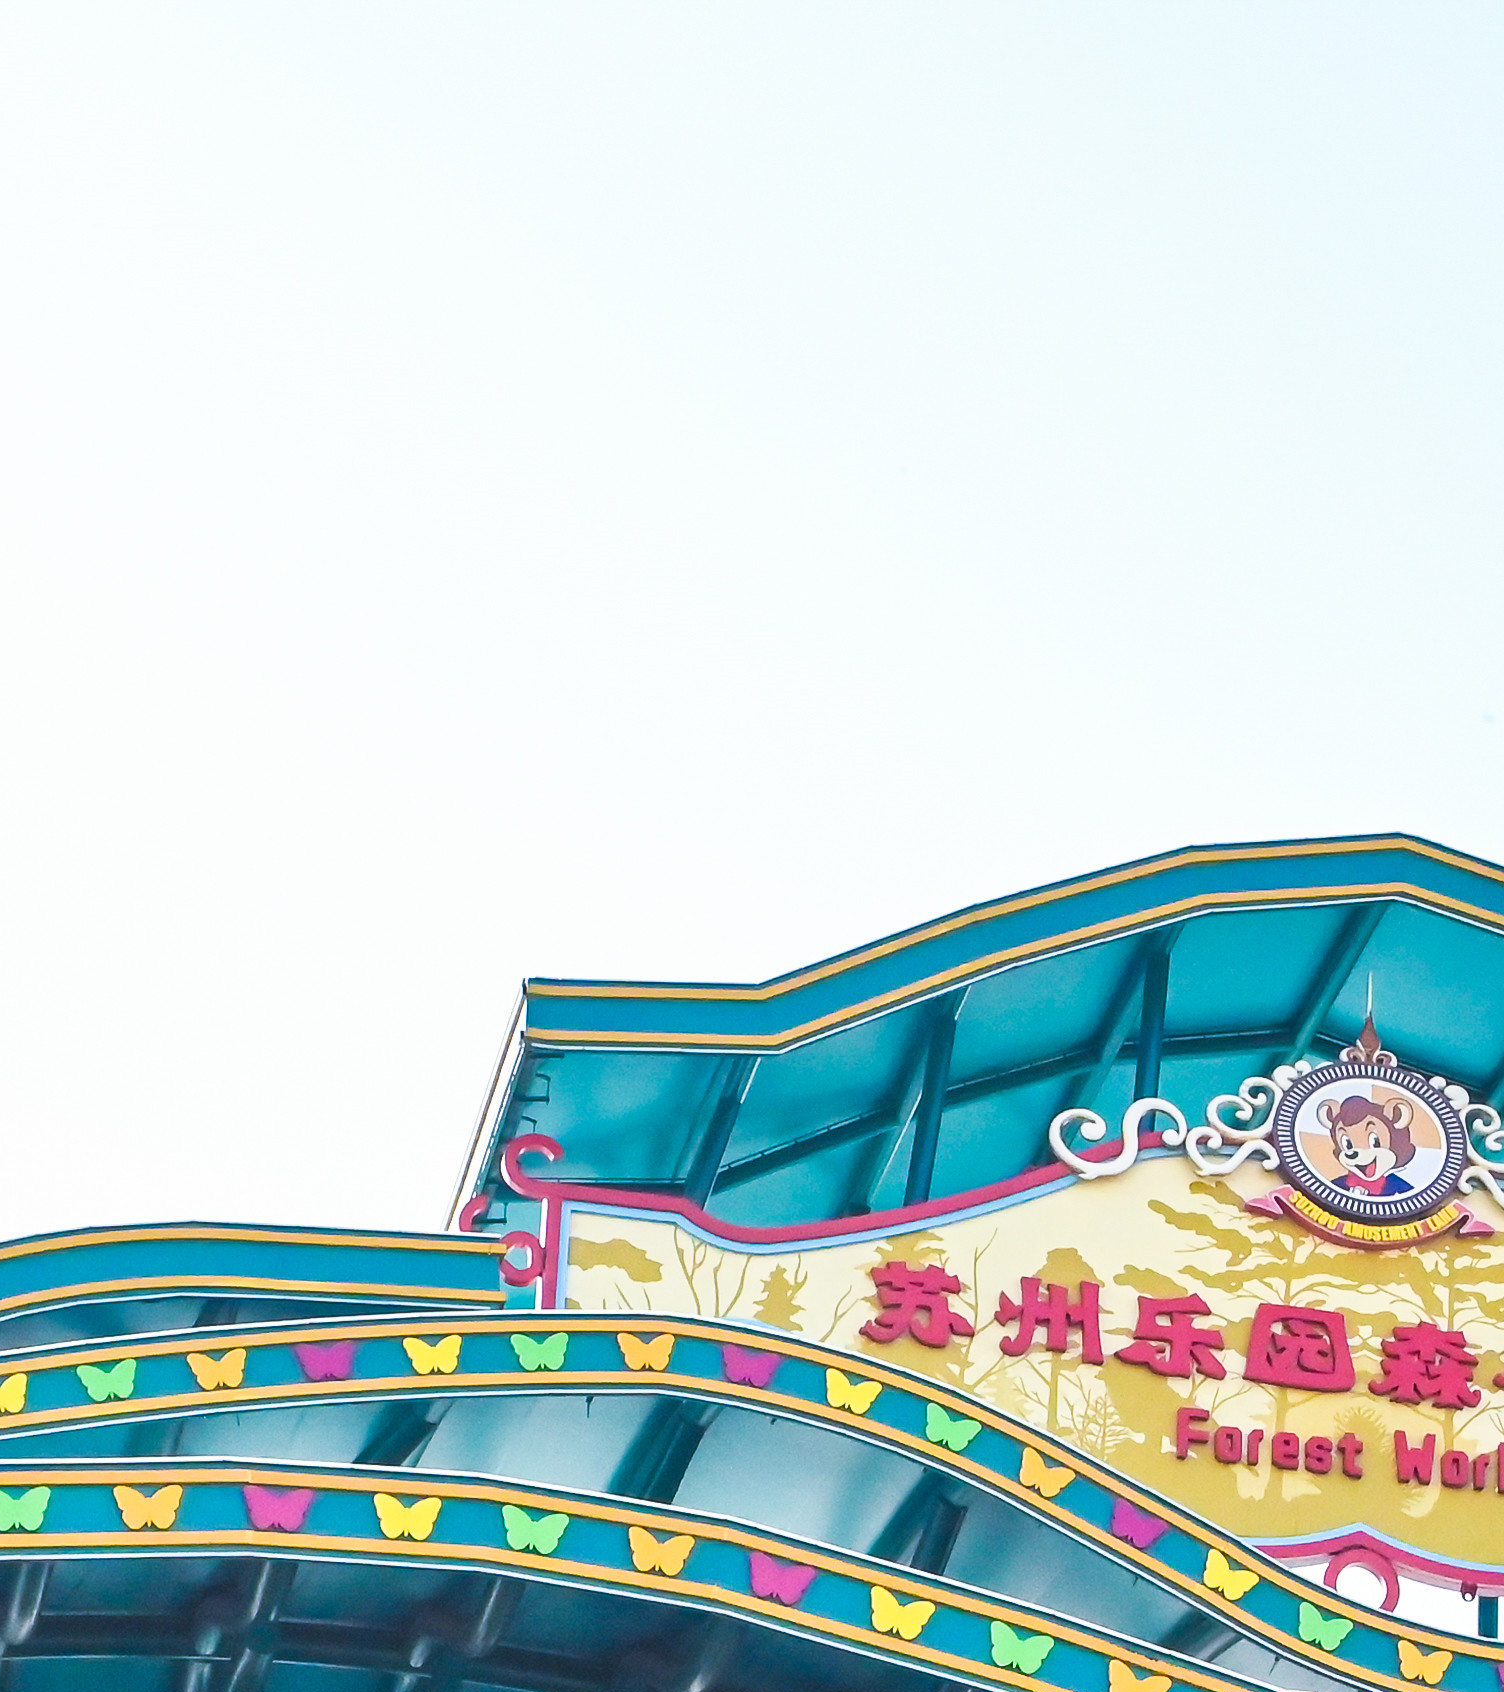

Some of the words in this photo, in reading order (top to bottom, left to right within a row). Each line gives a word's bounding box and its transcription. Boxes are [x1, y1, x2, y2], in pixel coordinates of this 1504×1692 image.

[1289, 1190, 1340, 1230] SUZHOU
[1342, 1220, 1424, 1242] AMUSEMENT
[1426, 1204, 1461, 1232] LAND
[1175, 1406, 1364, 1480] Forest
